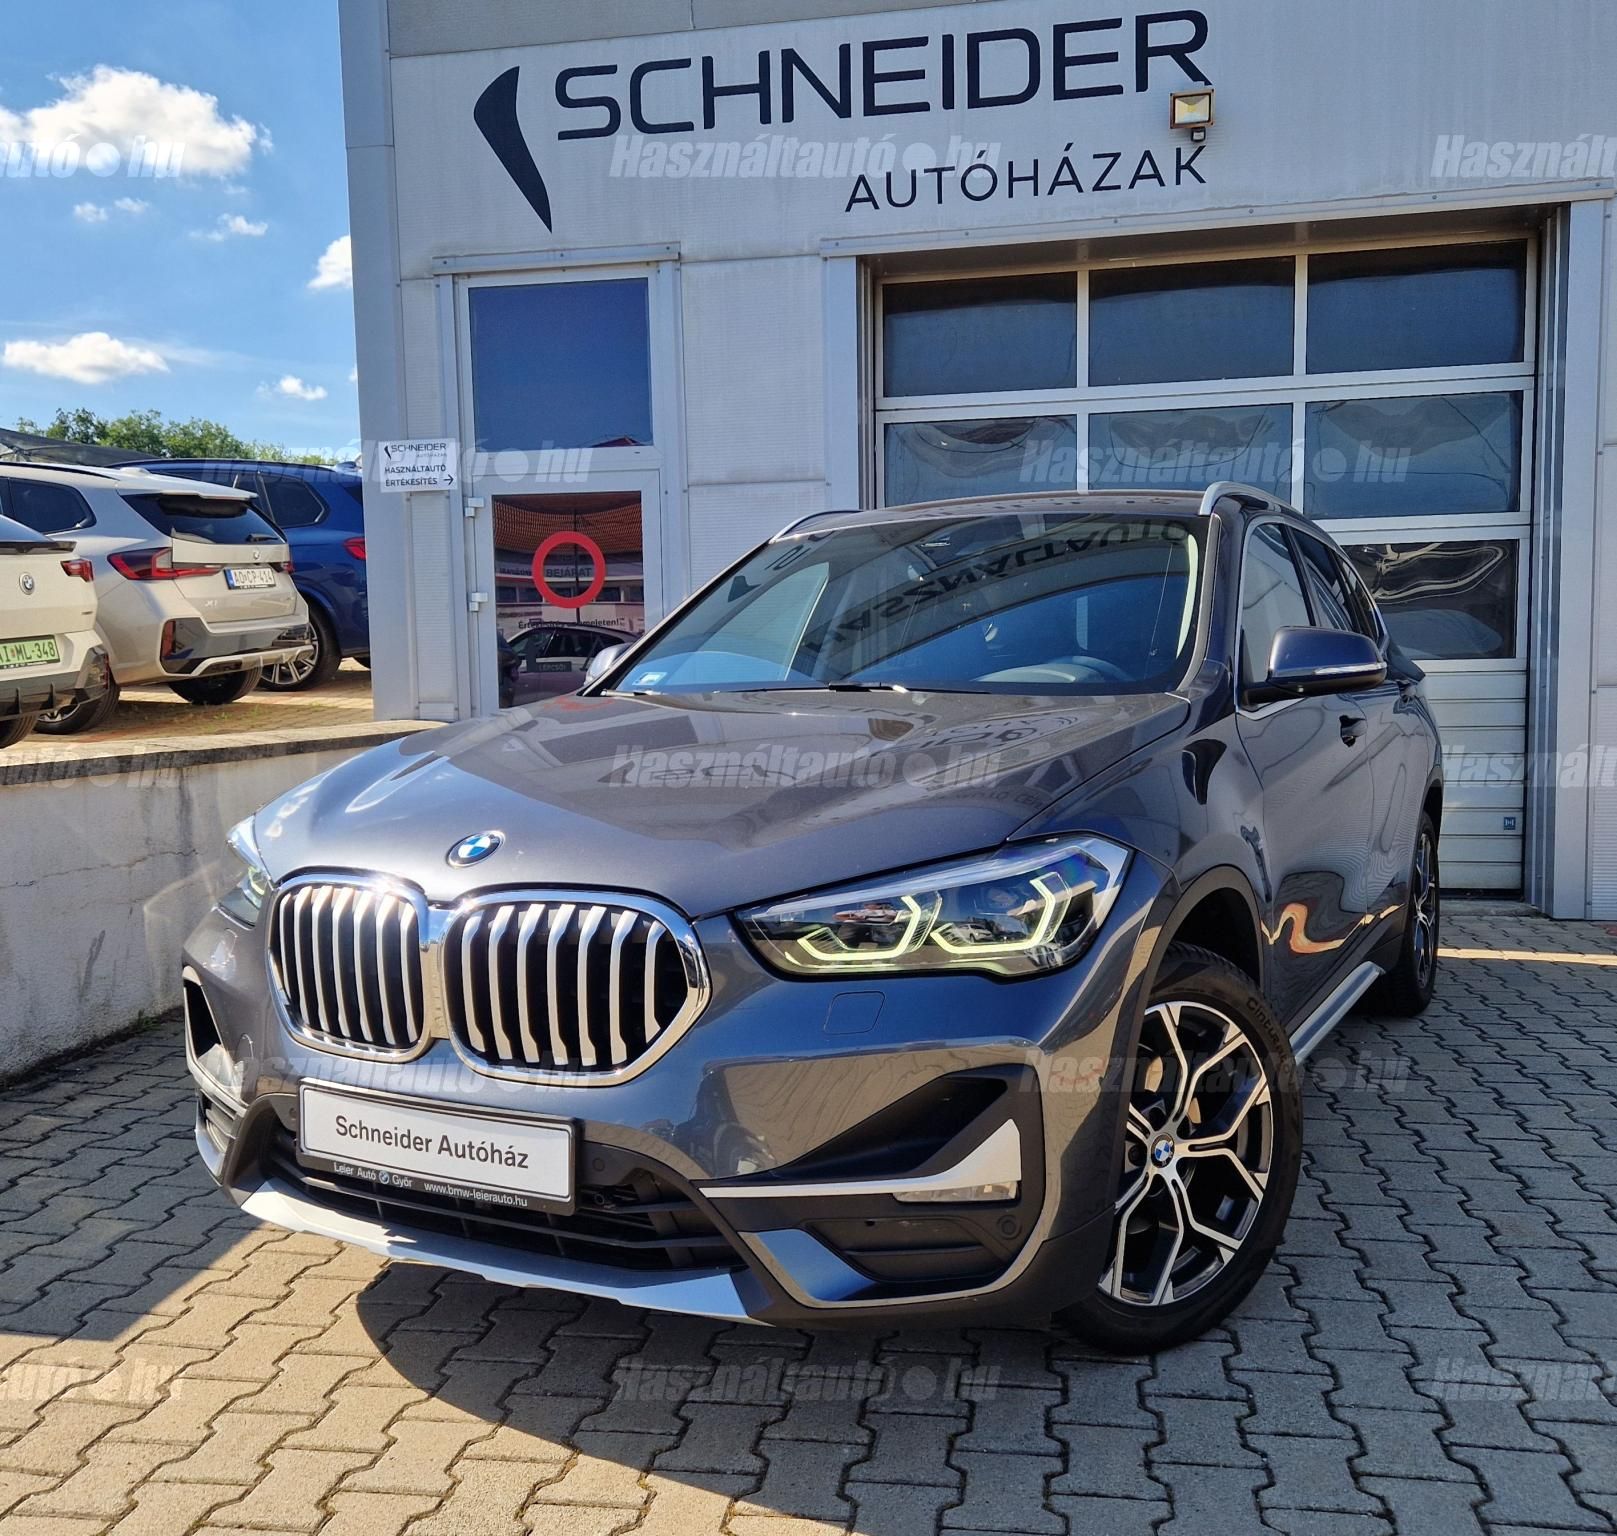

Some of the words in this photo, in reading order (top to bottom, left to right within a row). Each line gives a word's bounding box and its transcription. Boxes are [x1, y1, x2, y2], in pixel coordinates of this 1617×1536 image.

[555, 9, 1214, 140] SCHNEIDER
[845, 141, 1208, 213] AUTÓHÁZAK
[391, 442, 447, 453] SCHNEIDER
[384, 464, 447, 474] HASZNÁLTAUTÓ
[385, 476, 438, 487] ÉRTÉKESÍTÉS
[546, 566, 592, 578] BEJÁRAT
[335, 1115, 433, 1153] Schneider
[438, 1135, 529, 1169] Autóház
[334, 1161, 354, 1176] Leier
[357, 1167, 377, 1181] Autó
[392, 1173, 412, 1189] Győr
[424, 1180, 528, 1207] www.bmw-leierauto.hu
